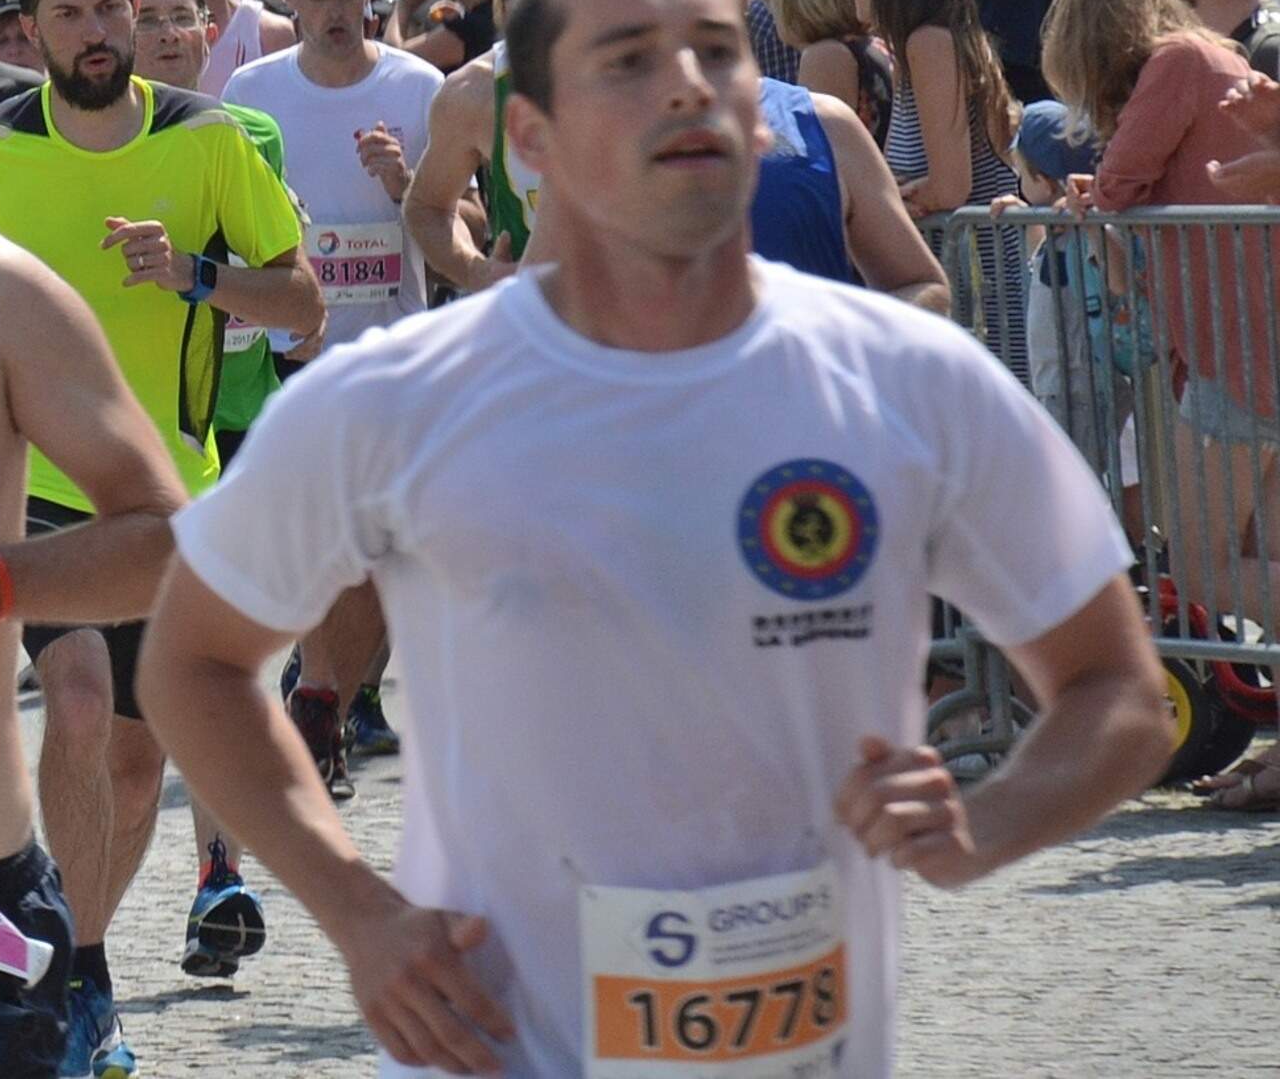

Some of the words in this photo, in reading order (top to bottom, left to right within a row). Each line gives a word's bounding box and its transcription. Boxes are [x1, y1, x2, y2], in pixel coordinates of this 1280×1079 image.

[346, 238, 388, 250] TOTAL
[321, 260, 385, 282] 8184
[708, 894, 814, 933] GROUP
[630, 969, 836, 1050] 16778
